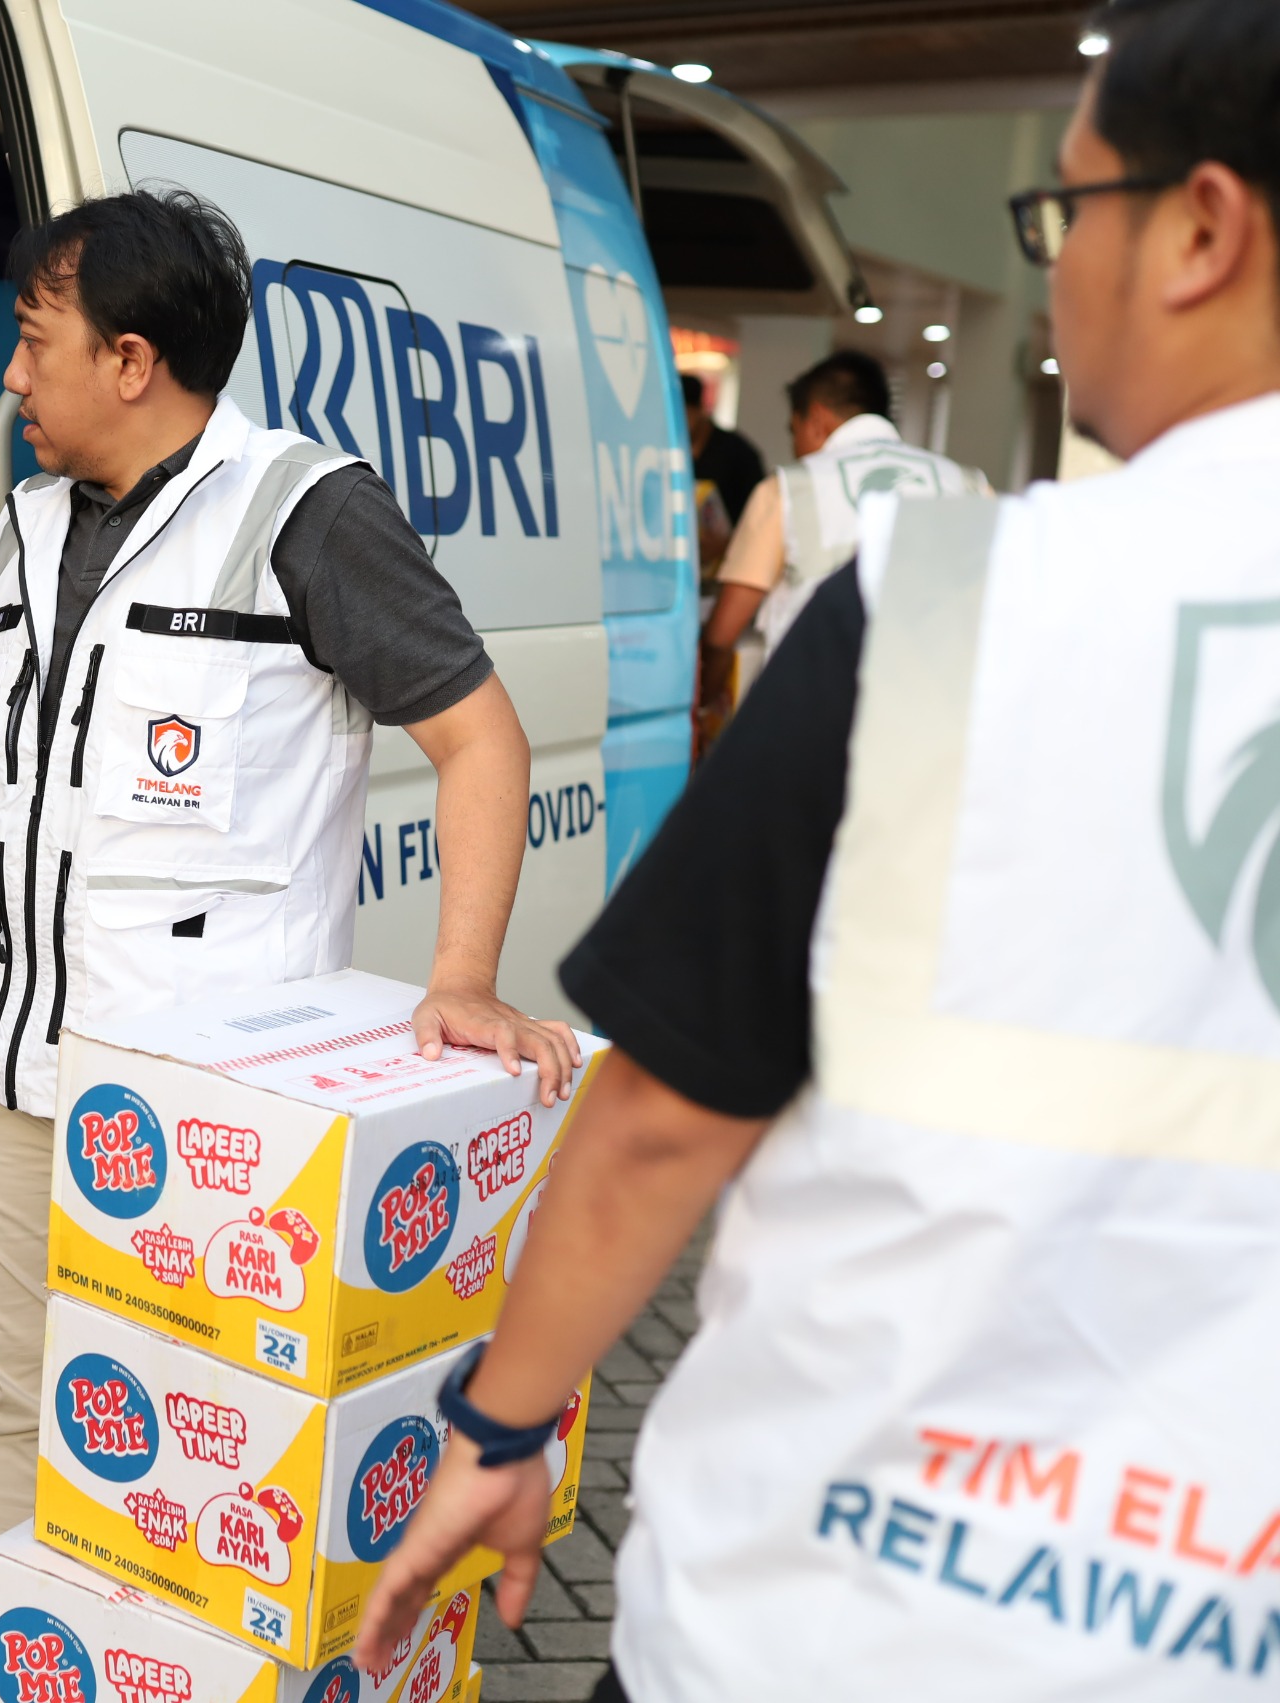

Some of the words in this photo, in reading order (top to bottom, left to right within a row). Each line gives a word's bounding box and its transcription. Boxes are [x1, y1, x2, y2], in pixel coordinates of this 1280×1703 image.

[385, 306, 560, 538] BRI
[169, 612, 206, 632] BRI
[131, 793, 181, 808] RELAWAN
[184, 799, 200, 810] BRI
[528, 781, 606, 850] OVID-
[81, 1109, 139, 1158] POP
[146, 1112, 157, 1130] CUP
[179, 1120, 260, 1163] LAPEER
[468, 1112, 531, 1178] LAPEER
[93, 1143, 157, 1192] MIE
[188, 1157, 250, 1194] TIME
[478, 1148, 525, 1201] TIME
[379, 1162, 436, 1243] POP
[144, 1232, 167, 1247] RASA
[168, 1236, 192, 1251] LEBIH
[239, 1230, 263, 1246] RASA
[389, 1187, 450, 1273] MIE
[143, 1249, 194, 1277] ENAK
[228, 1241, 276, 1275] KARI
[456, 1251, 474, 1269] RASA
[474, 1238, 495, 1258] LEBIH
[161, 1271, 185, 1288] SOB!
[225, 1266, 283, 1299] AYAM
[455, 1252, 495, 1292] ENAK
[56, 1265, 89, 1289] BPOM
[91, 1278, 102, 1295] RI
[105, 1282, 123, 1302] MD
[125, 1293, 221, 1341] 240935009000027
[258, 1323, 301, 1345] ISI/CONTENT
[262, 1335, 298, 1366] 24
[266, 1356, 291, 1372] CUPS
[70, 1378, 128, 1420] POP
[136, 1384, 146, 1401] CUP
[84, 1411, 149, 1456] MIE
[167, 1395, 245, 1442] LAPEER
[178, 1429, 240, 1467] TIME
[361, 1435, 415, 1521] POP
[918, 1426, 1083, 1524] TIM
[138, 1496, 160, 1511] RASA
[159, 1500, 184, 1518] LEBIH
[230, 1502, 253, 1519] RASA
[371, 1456, 429, 1543] MIE
[136, 1510, 186, 1542] ENAK
[153, 1533, 176, 1550] SOB!
[220, 1512, 264, 1548] KARI
[47, 1521, 78, 1547] BPOM
[81, 1538, 92, 1555] RI
[94, 1544, 112, 1563] MD
[114, 1554, 209, 1610] 240935009000027
[217, 1538, 270, 1572] AYAM
[247, 1595, 286, 1622] ISI/CONTENT
[249, 1607, 283, 1639] 24
[54, 1620, 74, 1641] INSTAN
[252, 1629, 277, 1646] CUPS
[3, 1631, 64, 1673] POP
[17, 1666, 86, 1703] MIE
[106, 1649, 191, 1695] LAPEER
[410, 1651, 441, 1696] KARI
